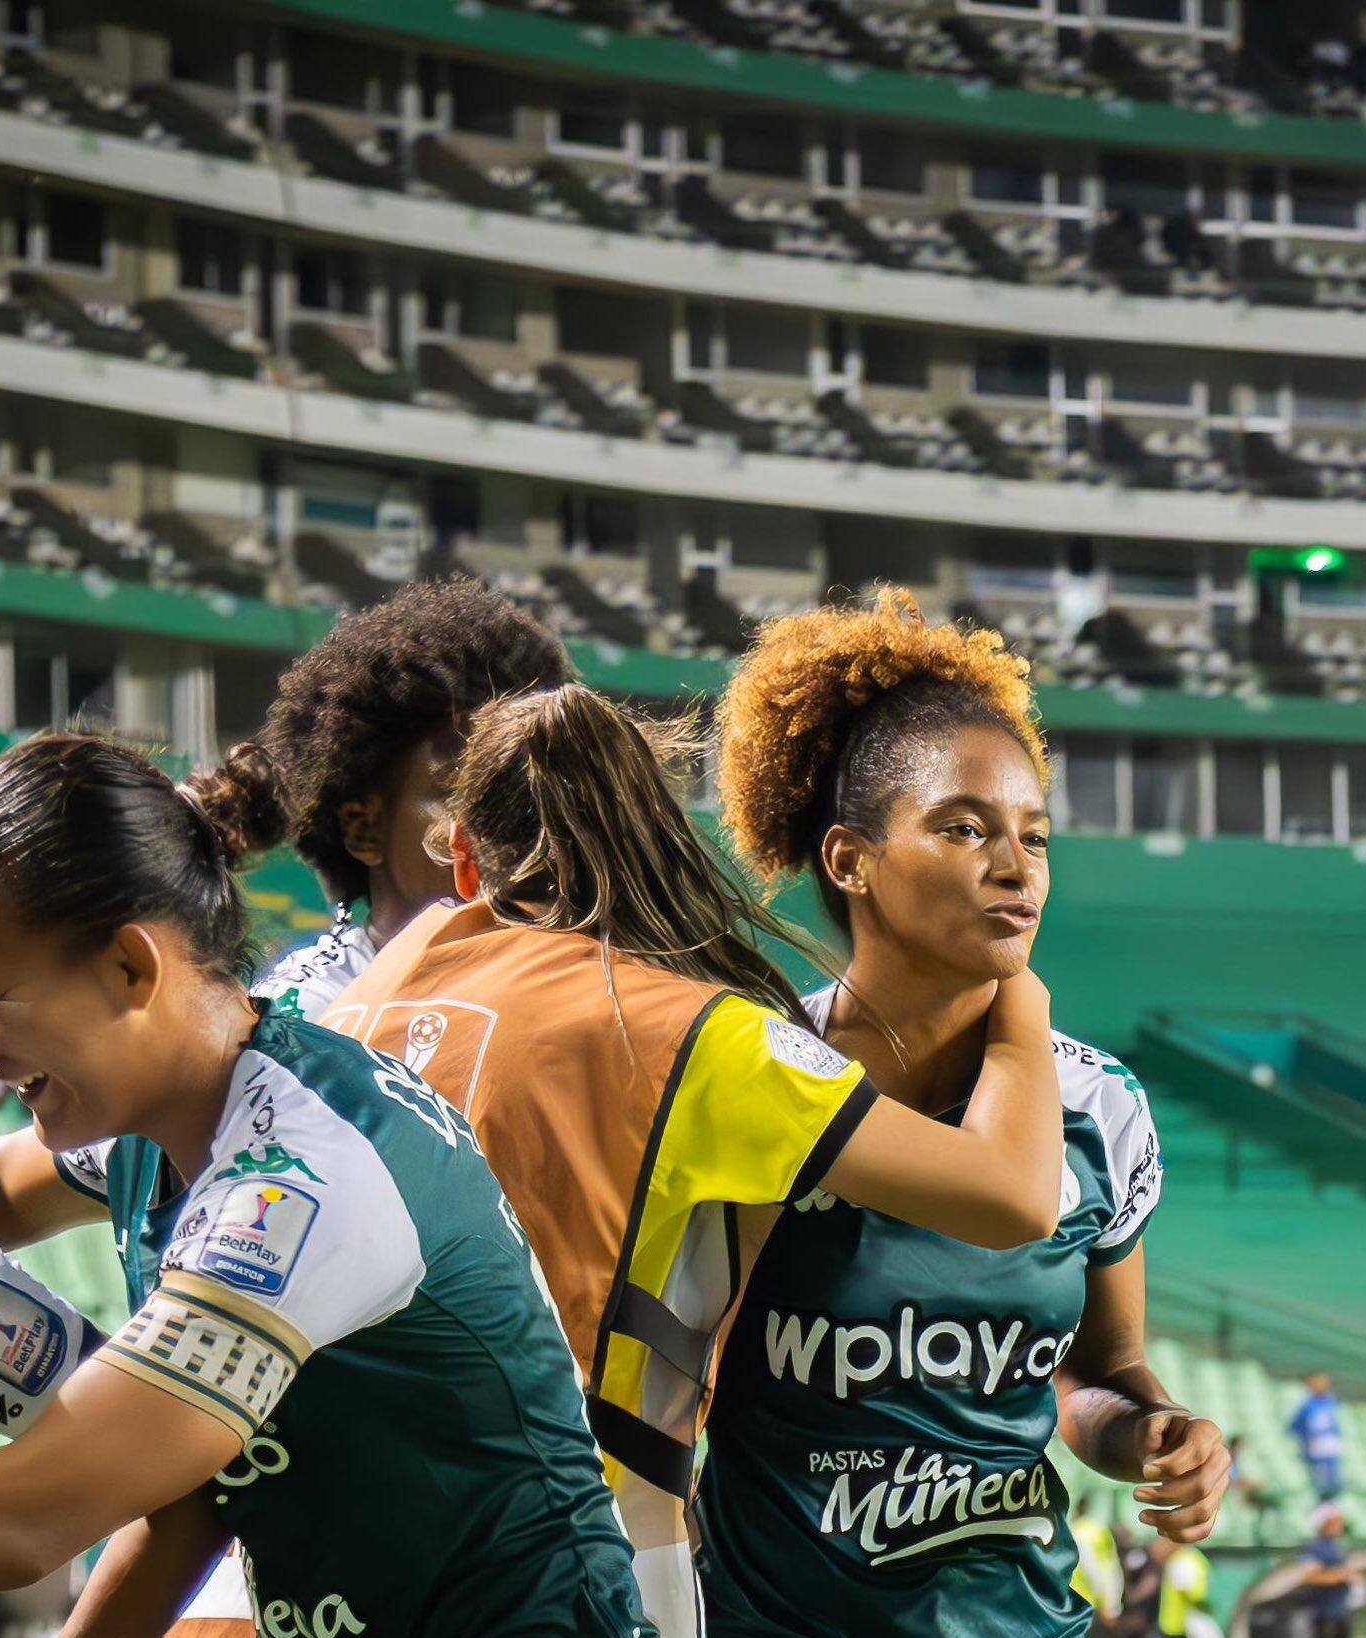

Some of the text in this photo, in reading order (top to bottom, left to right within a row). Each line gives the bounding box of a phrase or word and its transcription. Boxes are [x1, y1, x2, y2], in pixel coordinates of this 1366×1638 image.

[219, 1233, 282, 1268] BetPlay
[765, 1306, 1075, 1399] Wplay.co
[808, 1446, 946, 1485] PASTAS La
[819, 1463, 1050, 1553] Muñeca
